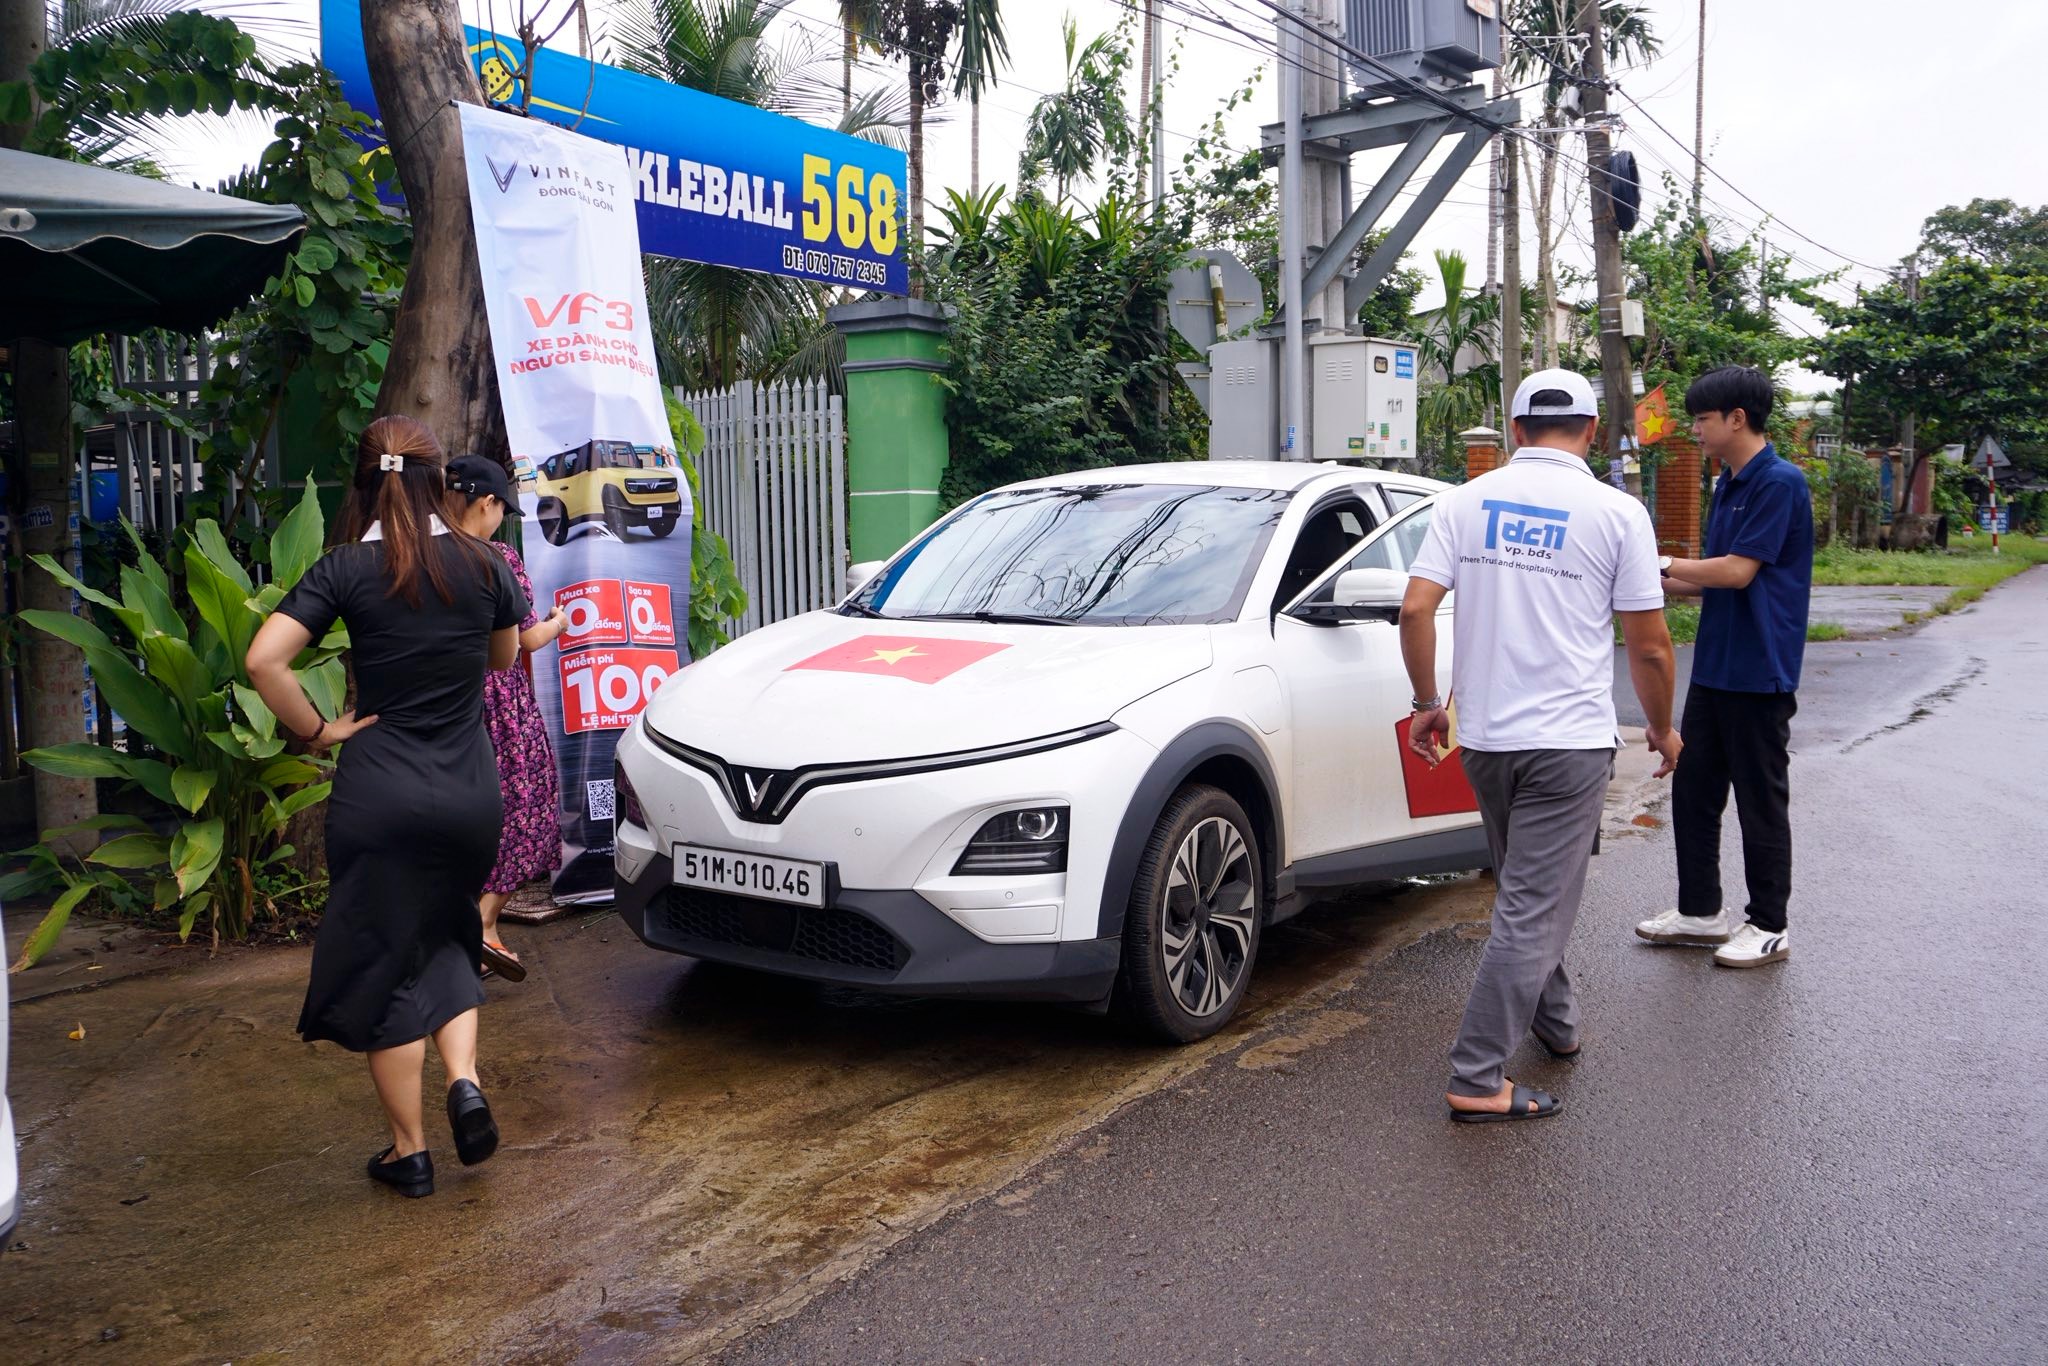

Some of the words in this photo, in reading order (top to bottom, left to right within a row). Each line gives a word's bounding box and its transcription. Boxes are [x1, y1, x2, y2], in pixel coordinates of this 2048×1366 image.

[529, 164, 615, 196] VINFAST
[539, 186, 577, 197] ĐÔNG
[802, 153, 898, 256] 568
[783, 245, 804, 272] ĐT:
[806, 250, 830, 275] 079
[832, 254, 855, 279] 757
[857, 260, 886, 285] 2345
[527, 338, 554, 353] XE
[556, 332, 608, 350] DÀNH
[611, 339, 639, 357] CHO
[510, 350, 576, 374] NGƯỜI
[579, 349, 627, 366] SÀNH
[628, 356, 654, 377] ĐIỆU
[1504, 545, 1525, 556] vp.
[1498, 560, 1514, 568] and
[1515, 561, 1559, 577] Hospitality
[1560, 569, 1583, 581] Meet
[560, 590, 583, 601] Mua
[585, 585, 600, 594] xe
[628, 586, 642, 598] Sạc
[564, 597, 599, 637] 0
[594, 617, 622, 630] đồng
[630, 597, 655, 635] 0
[652, 621, 671, 633] đồng
[564, 654, 596, 670] Miễn
[597, 653, 614, 664] phí
[566, 664, 669, 714] 100
[581, 713, 599, 728] LỆ
[601, 713, 618, 725] PHÍ
[618, 714, 640, 724] TR
[685, 852, 810, 897] 51M-010.46
